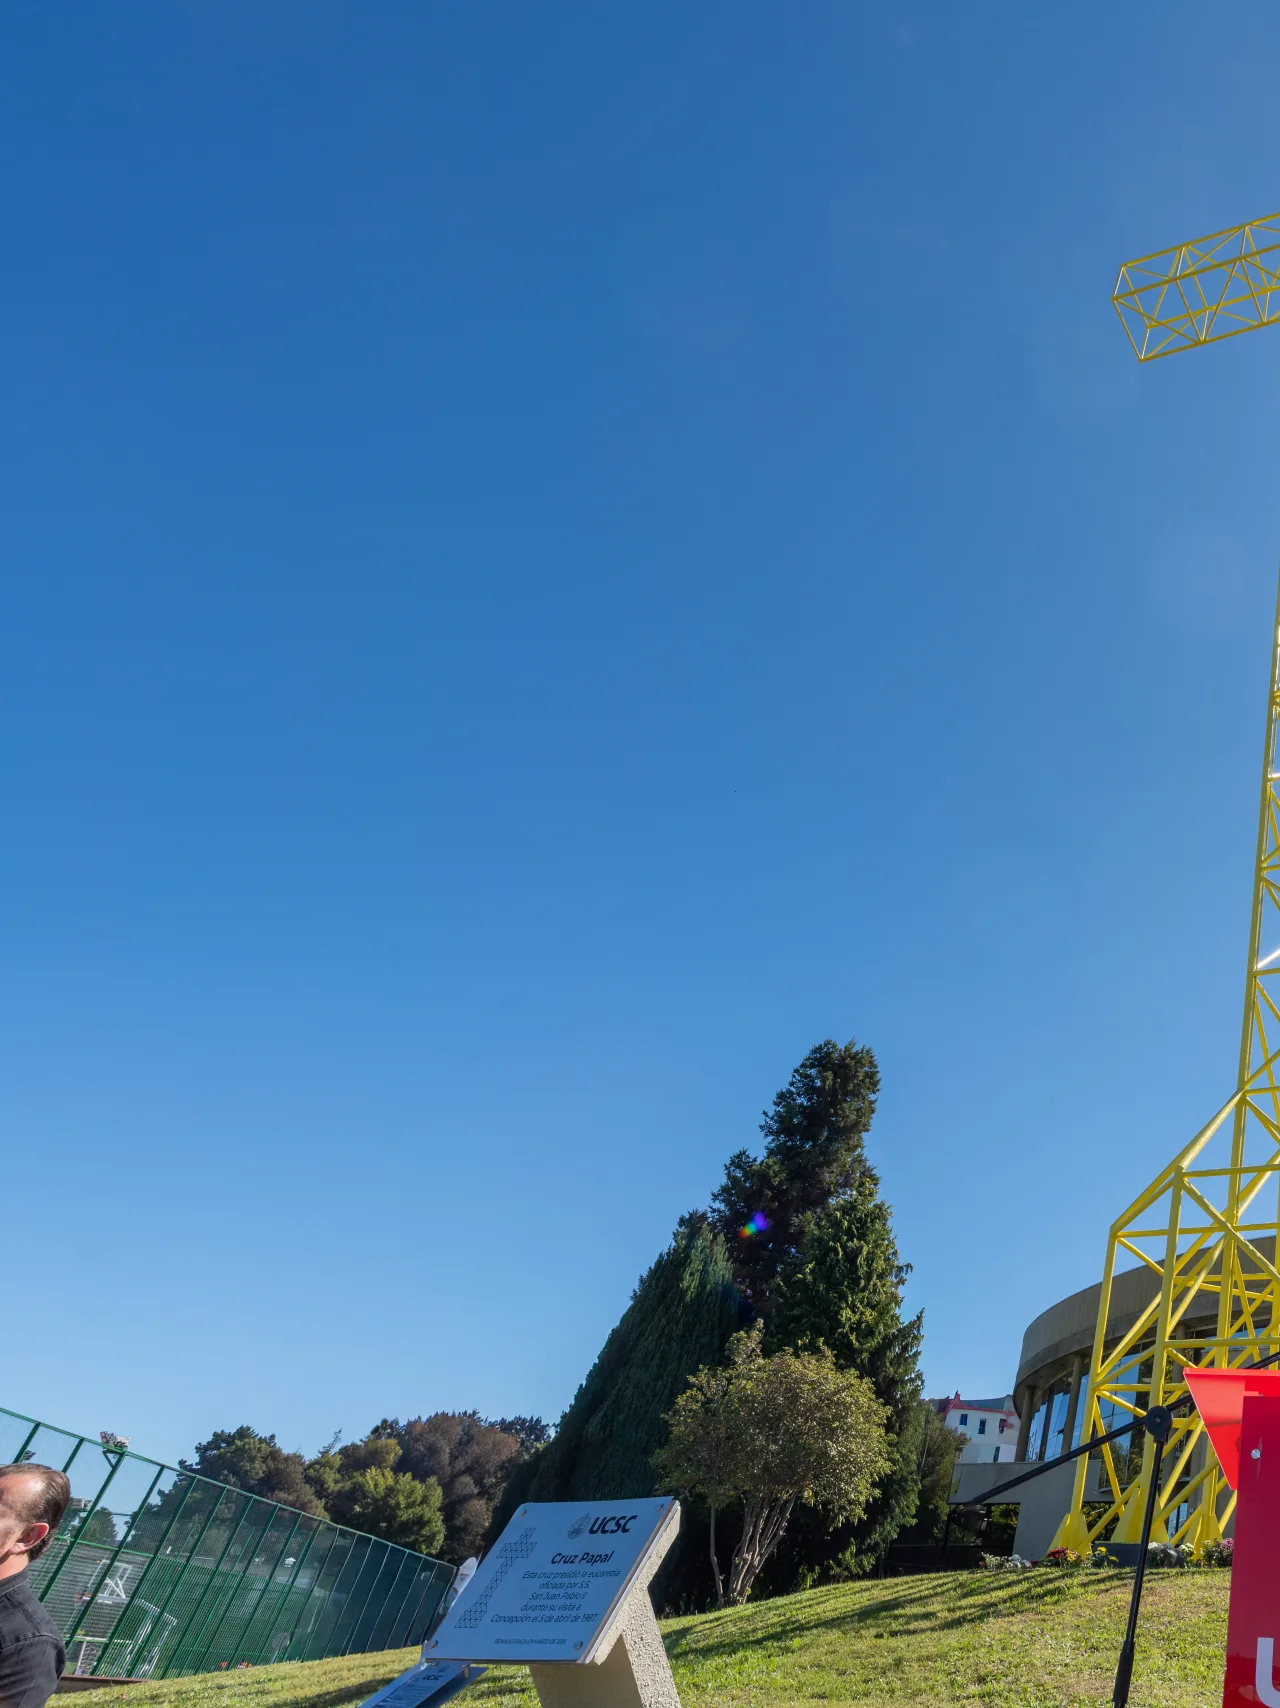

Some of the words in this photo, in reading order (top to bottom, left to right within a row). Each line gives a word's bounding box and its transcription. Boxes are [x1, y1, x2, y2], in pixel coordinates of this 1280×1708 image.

[588, 1514, 638, 1534] UCSC
[551, 1552, 579, 1564] Cruz
[578, 1551, 615, 1566] Papal
[522, 1571, 537, 1579] Esta
[537, 1571, 553, 1579] cruz
[552, 1570, 581, 1580] presidió
[581, 1569, 588, 1578] la
[539, 1580, 566, 1590] oficiada
[564, 1581, 579, 1591] por
[529, 1592, 544, 1601] San
[542, 1592, 561, 1600] Juan
[560, 1591, 581, 1600] Pablo
[520, 1602, 548, 1612] durante
[557, 1602, 574, 1611] visita
[490, 1613, 532, 1624] Concepción
[531, 1614, 540, 1623] el
[544, 1614, 553, 1623] de
[553, 1613, 571, 1623] abril
[570, 1614, 581, 1623] de
